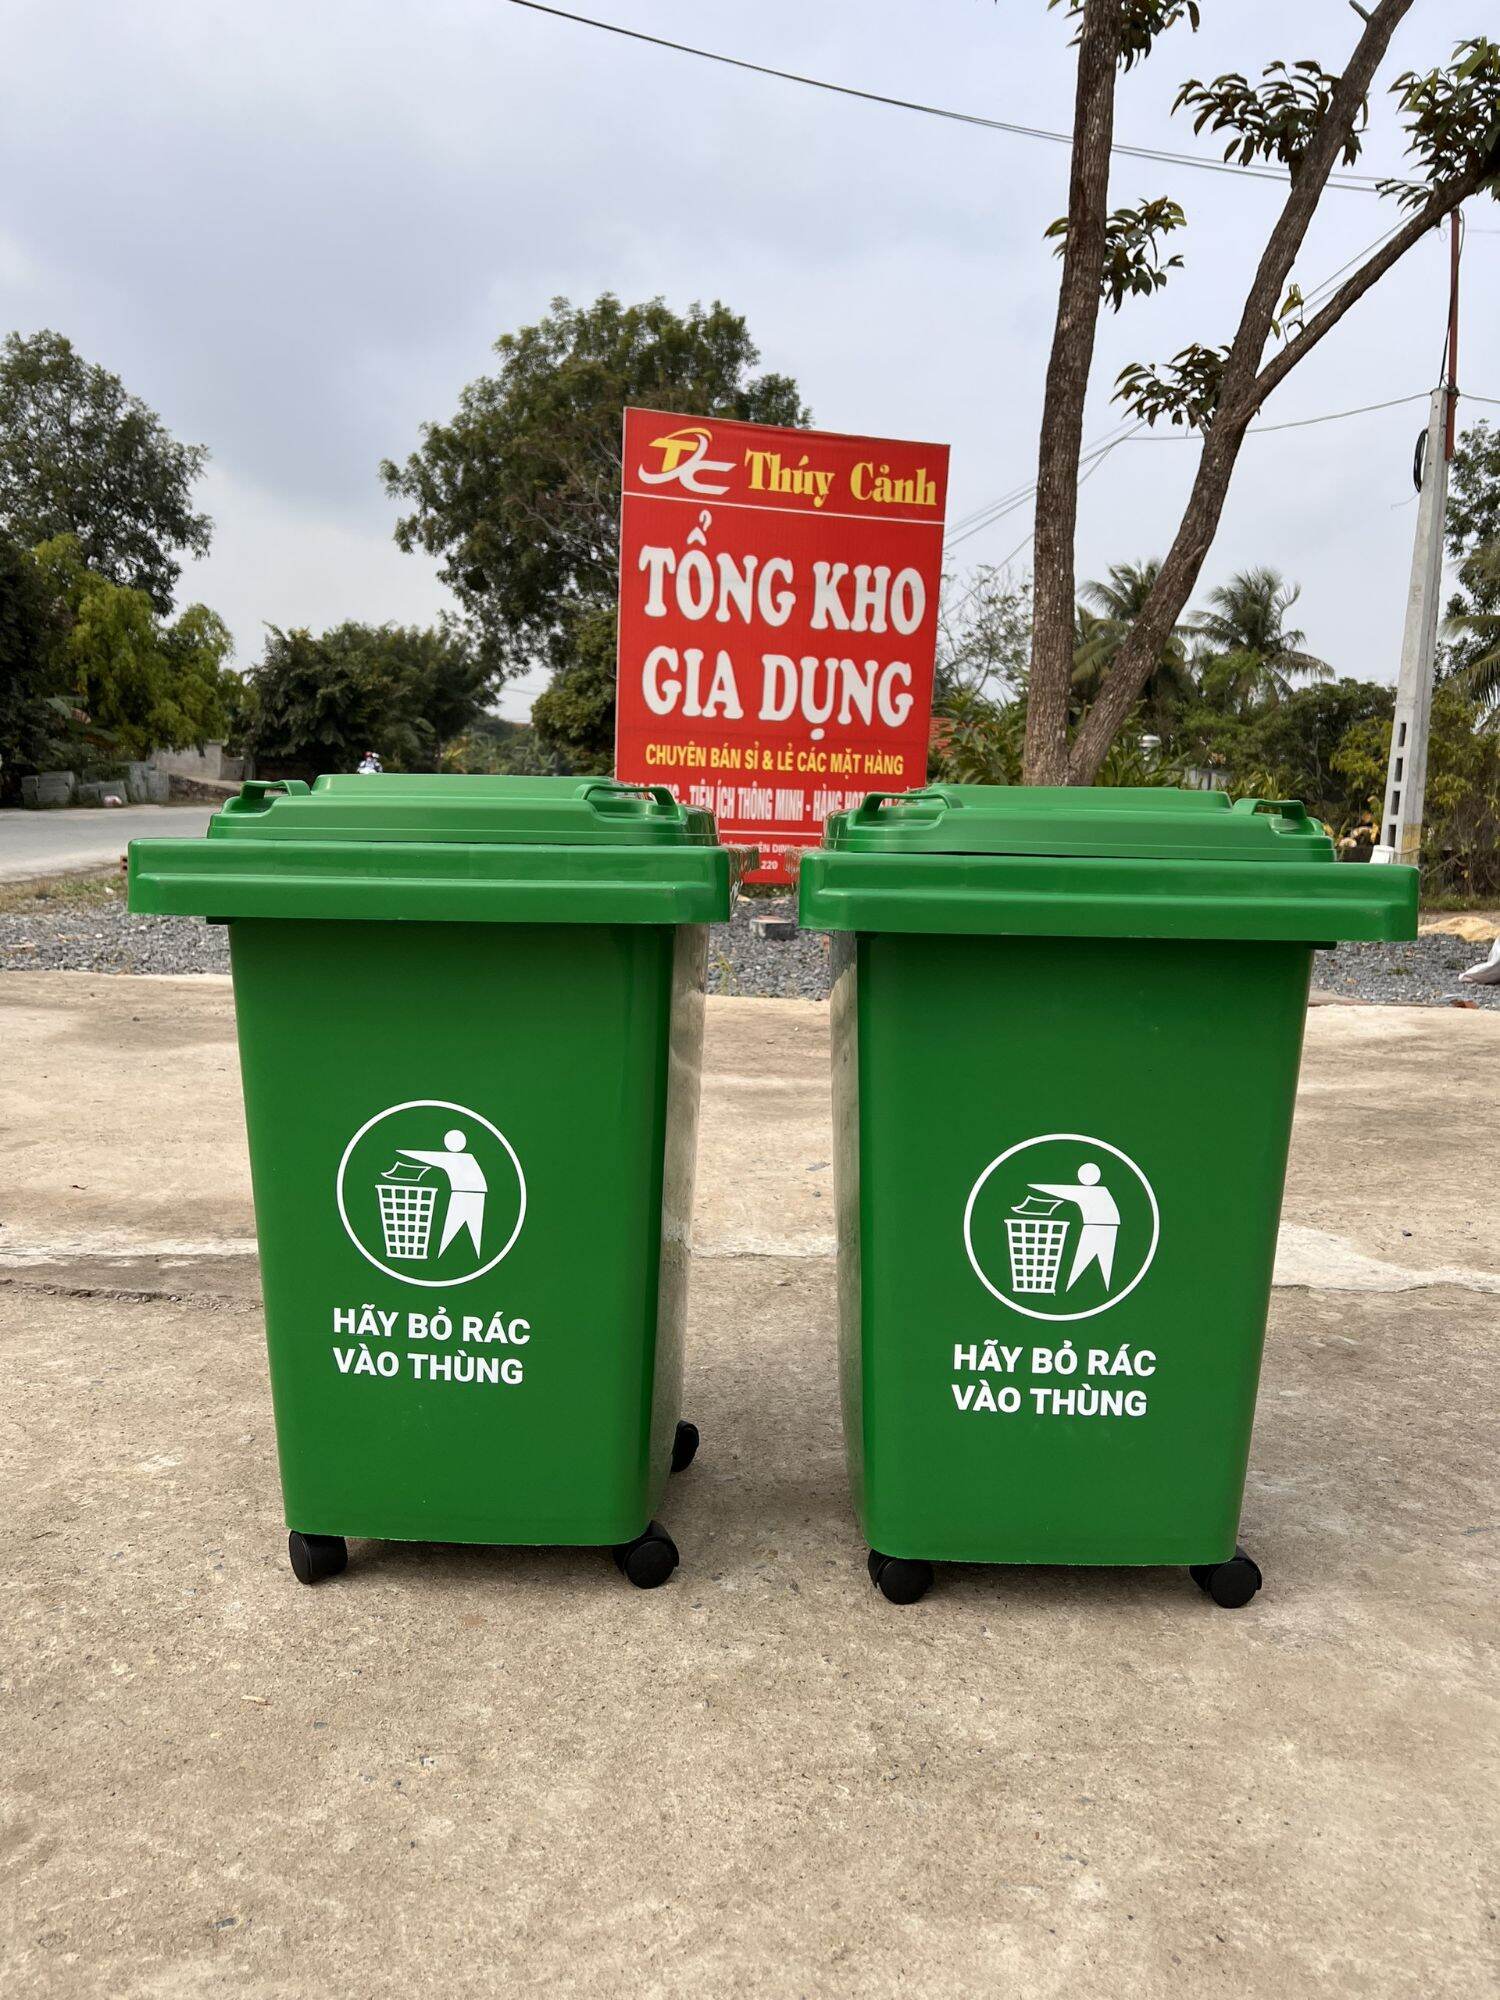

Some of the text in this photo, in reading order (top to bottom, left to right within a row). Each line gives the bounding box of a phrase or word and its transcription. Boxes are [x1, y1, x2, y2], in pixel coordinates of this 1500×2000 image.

[744, 448, 937, 508] Thúy Cảnh
[638, 509, 926, 635] TỔNG KHO
[642, 645, 914, 741] GIA DỤNG
[645, 740, 904, 779] CHUYÊN BÁN SỈ & LẺ CÁC MẶT HÀNG
[738, 781, 773, 820] THÔNG
[775, 788, 804, 821] MINH
[333, 1303, 531, 1345] HÃY BỎ RÁC
[332, 1343, 524, 1385] VÀO THÙNG
[953, 1339, 1157, 1377] HÃY BỎ RÁC
[951, 1379, 1147, 1417] VÀO THÙNG
